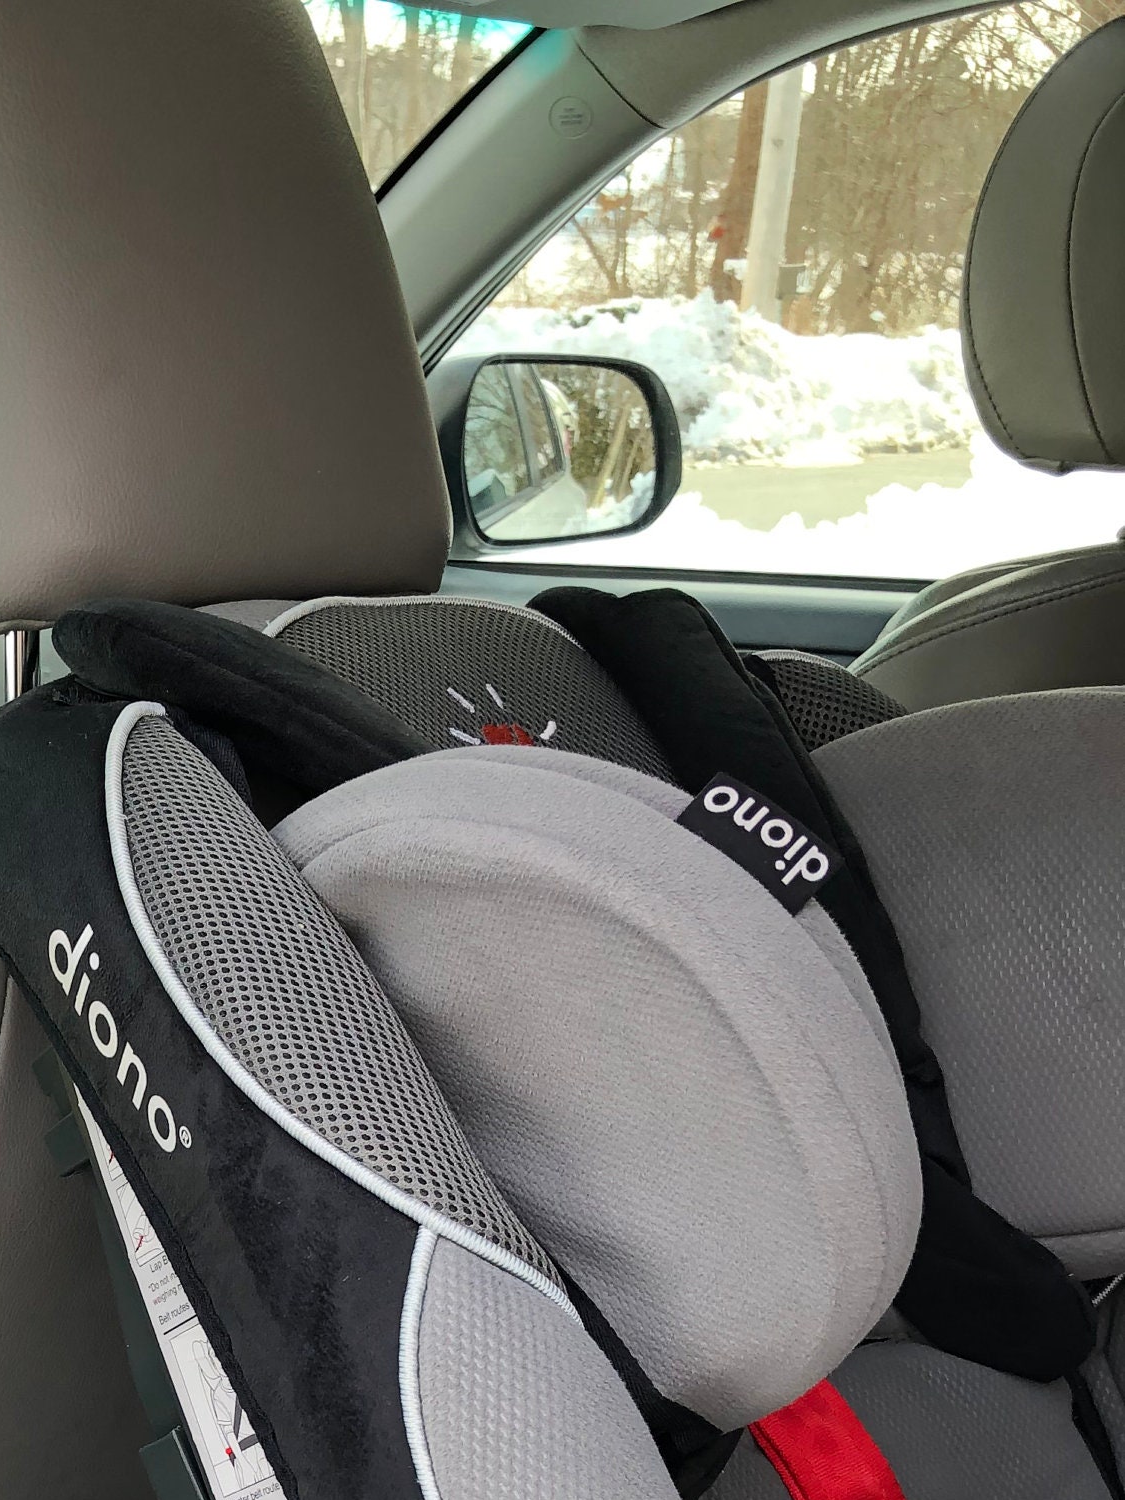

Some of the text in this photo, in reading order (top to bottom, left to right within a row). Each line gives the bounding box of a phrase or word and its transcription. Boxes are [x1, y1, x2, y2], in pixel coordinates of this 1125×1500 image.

[704, 786, 829, 886] diono
[48, 923, 177, 1153] diono
[150, 1261, 163, 1272] Lap
[153, 1286, 178, 1305] weighing
[158, 1302, 190, 1325] Belt routes
[250, 1489, 263, 1500] belt
